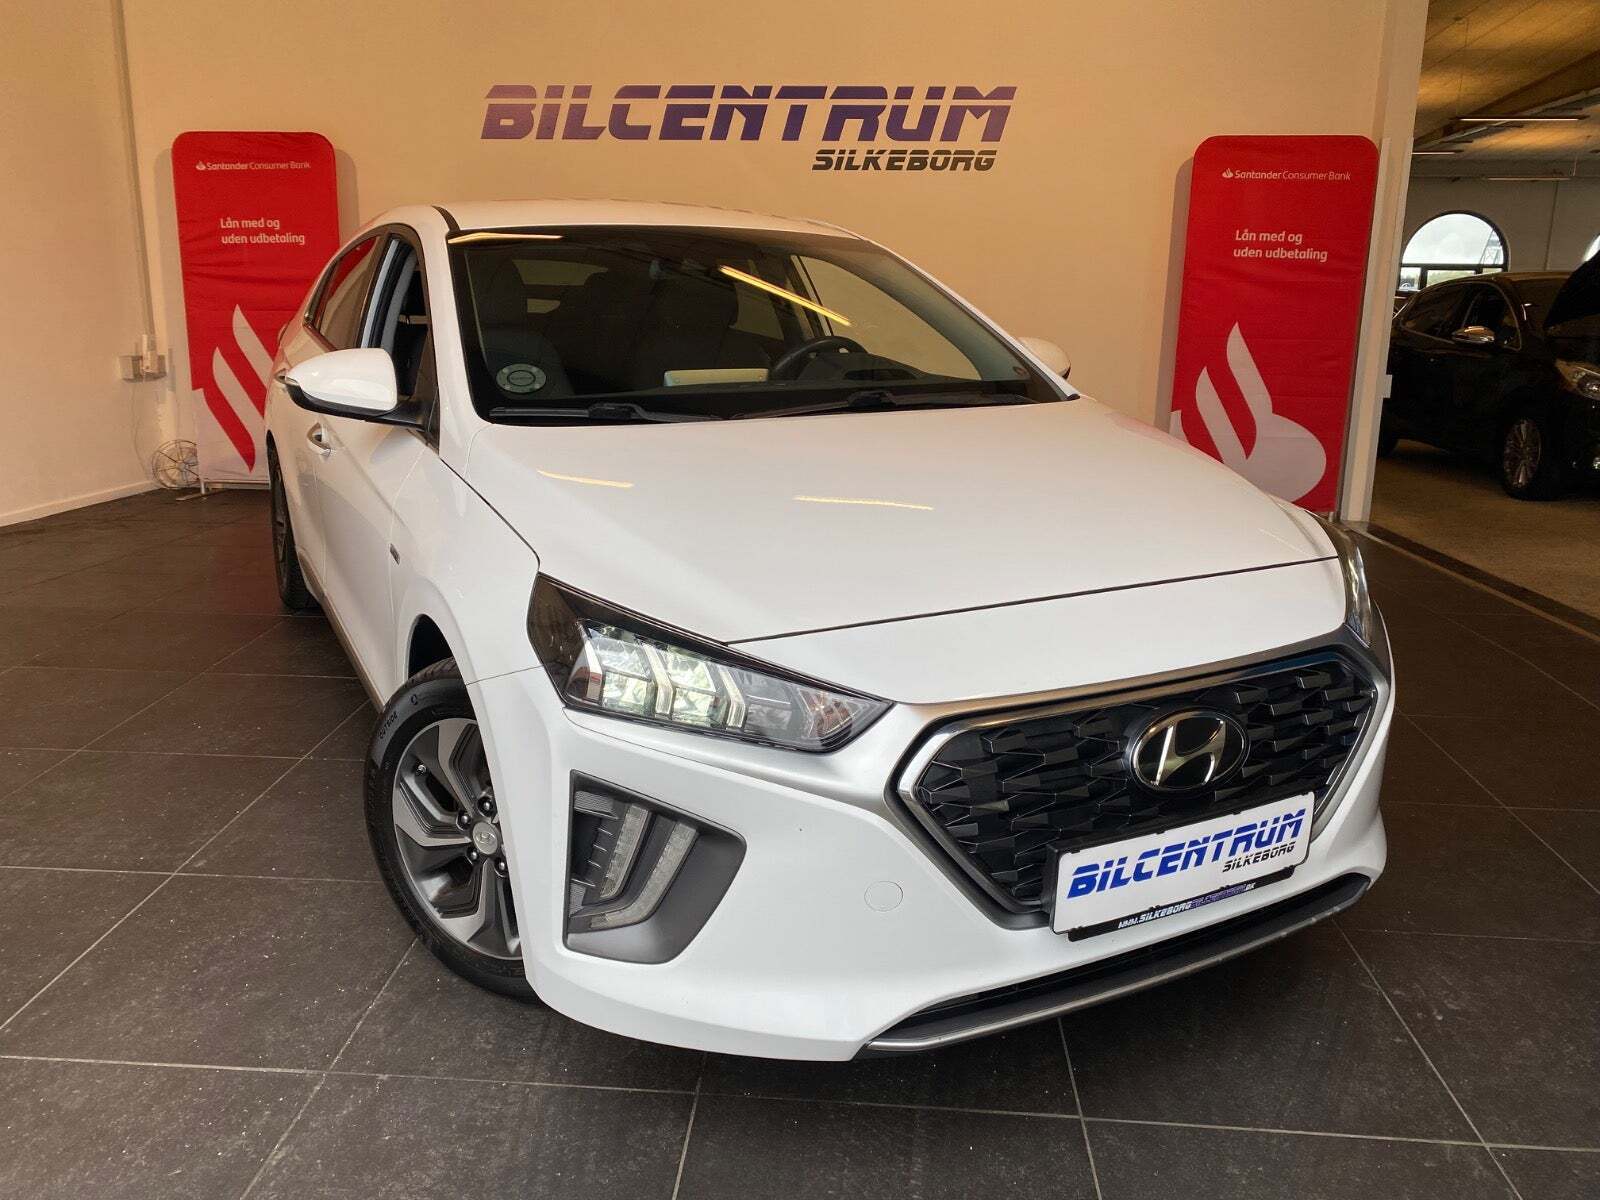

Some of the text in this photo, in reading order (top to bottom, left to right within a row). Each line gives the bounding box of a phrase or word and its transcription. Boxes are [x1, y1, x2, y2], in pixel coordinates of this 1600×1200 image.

[480, 84, 1017, 142] BILCENTRUM
[206, 160, 311, 171] Santander Consumer Bank
[811, 149, 998, 171] SILKEBORG
[1234, 169, 1352, 181] Santander Consumer Bank
[220, 217, 280, 230] Lån med og
[221, 233, 306, 246] uden udbetaling
[1235, 229, 1303, 245] Lån med og
[1233, 246, 1328, 263] uden udbetaling
[1067, 808, 1306, 899] BILCENTRUM
[1221, 841, 1296, 874] SILKEBORG
